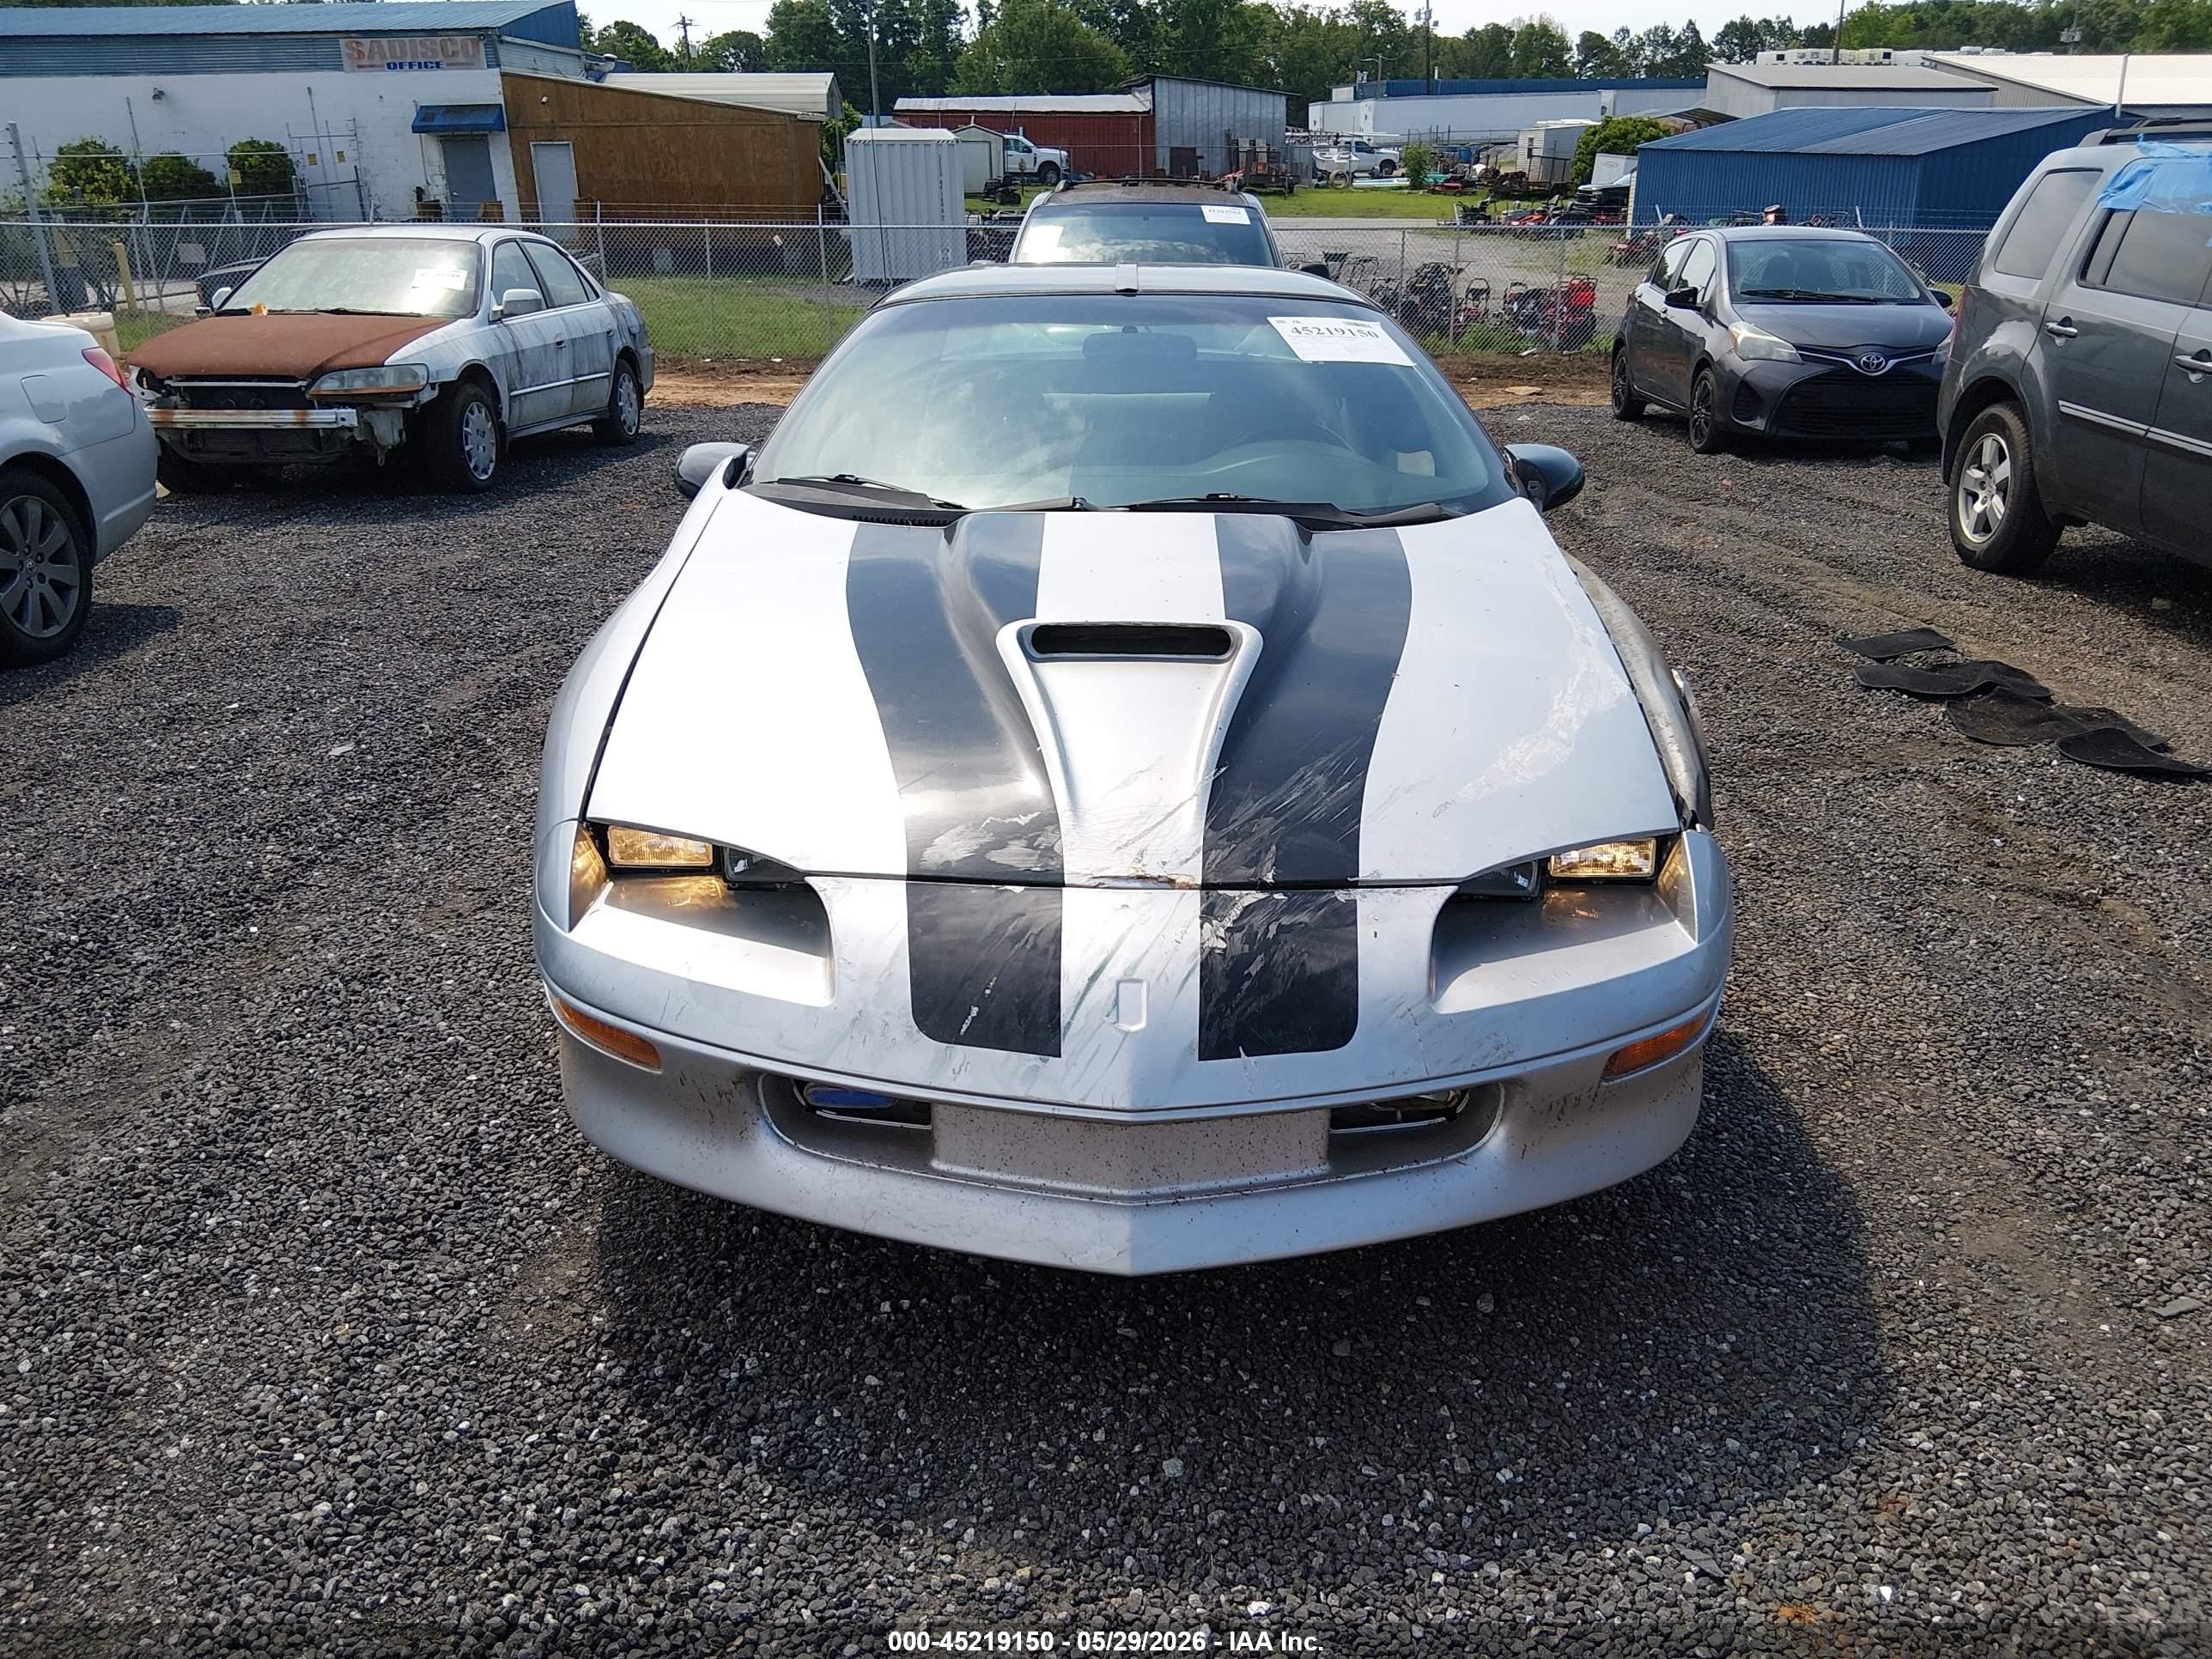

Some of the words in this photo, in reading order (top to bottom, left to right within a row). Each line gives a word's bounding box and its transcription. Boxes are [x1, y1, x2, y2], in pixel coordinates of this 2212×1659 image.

[344, 37, 481, 61] SADISCO
[386, 60, 445, 70] OFFICE
[1291, 326, 1380, 339] 45219150
